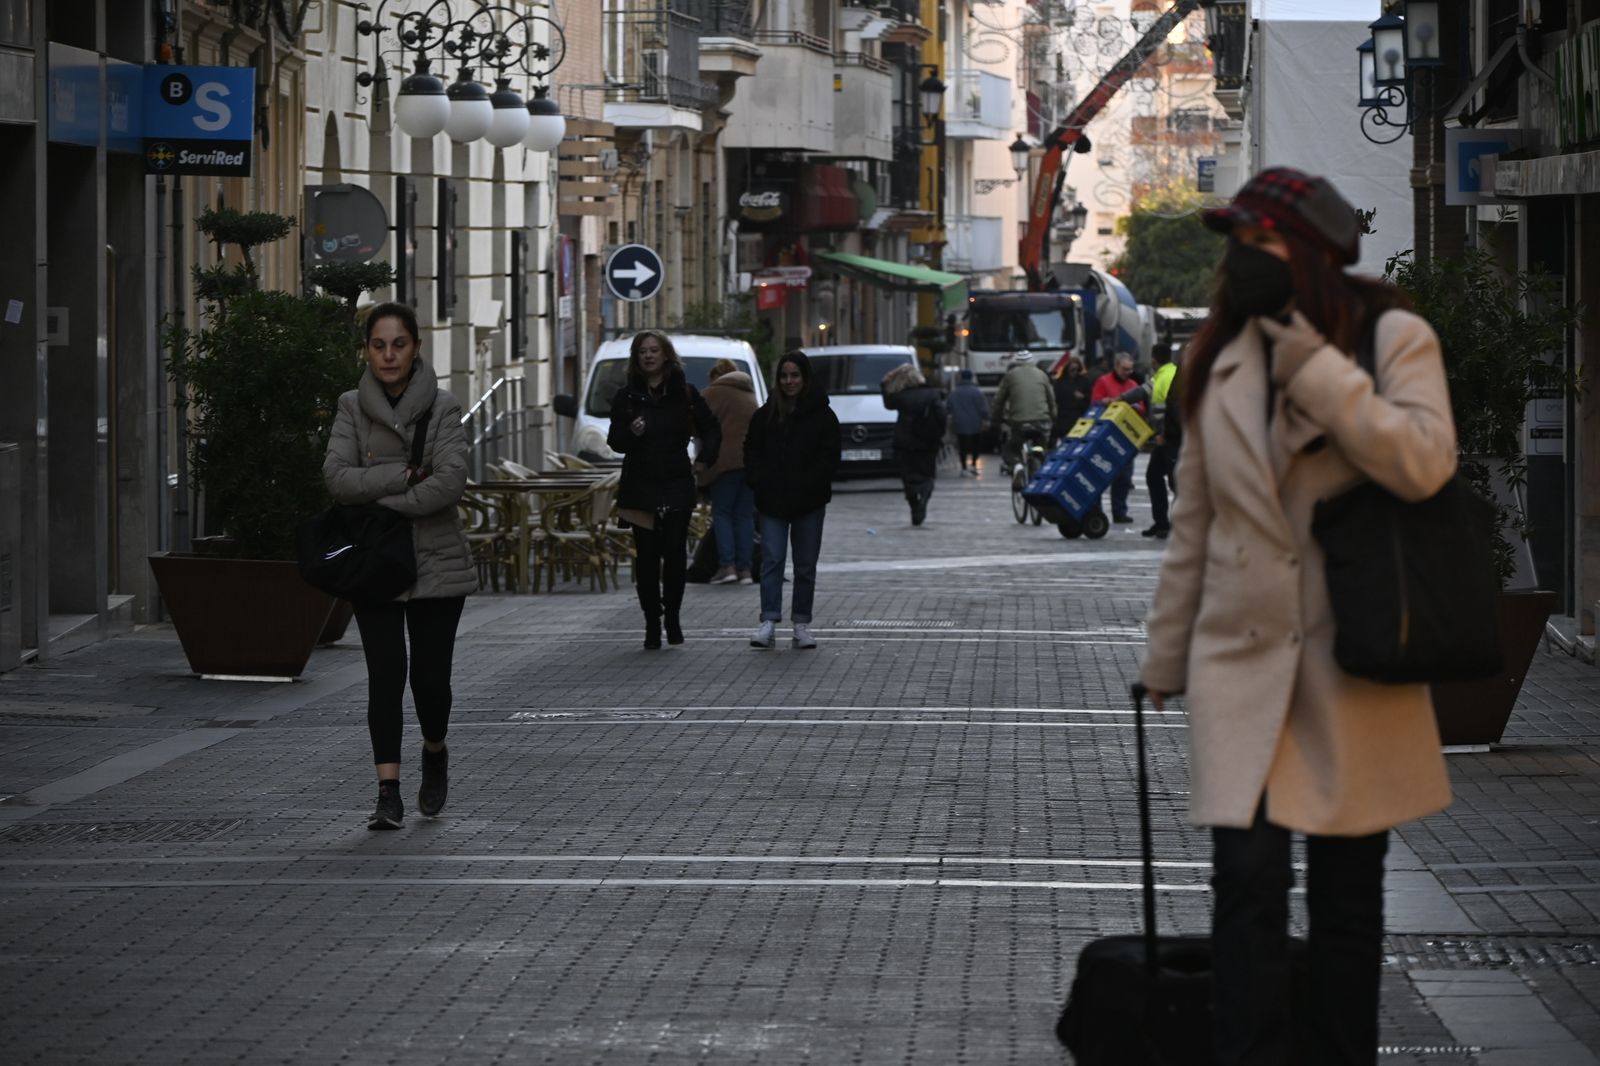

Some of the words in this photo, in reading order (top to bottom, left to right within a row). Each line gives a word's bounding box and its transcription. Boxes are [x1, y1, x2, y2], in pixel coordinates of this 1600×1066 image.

[169, 81, 184, 98] B
[192, 81, 232, 132] S
[178, 150, 245, 166] ServiRed
